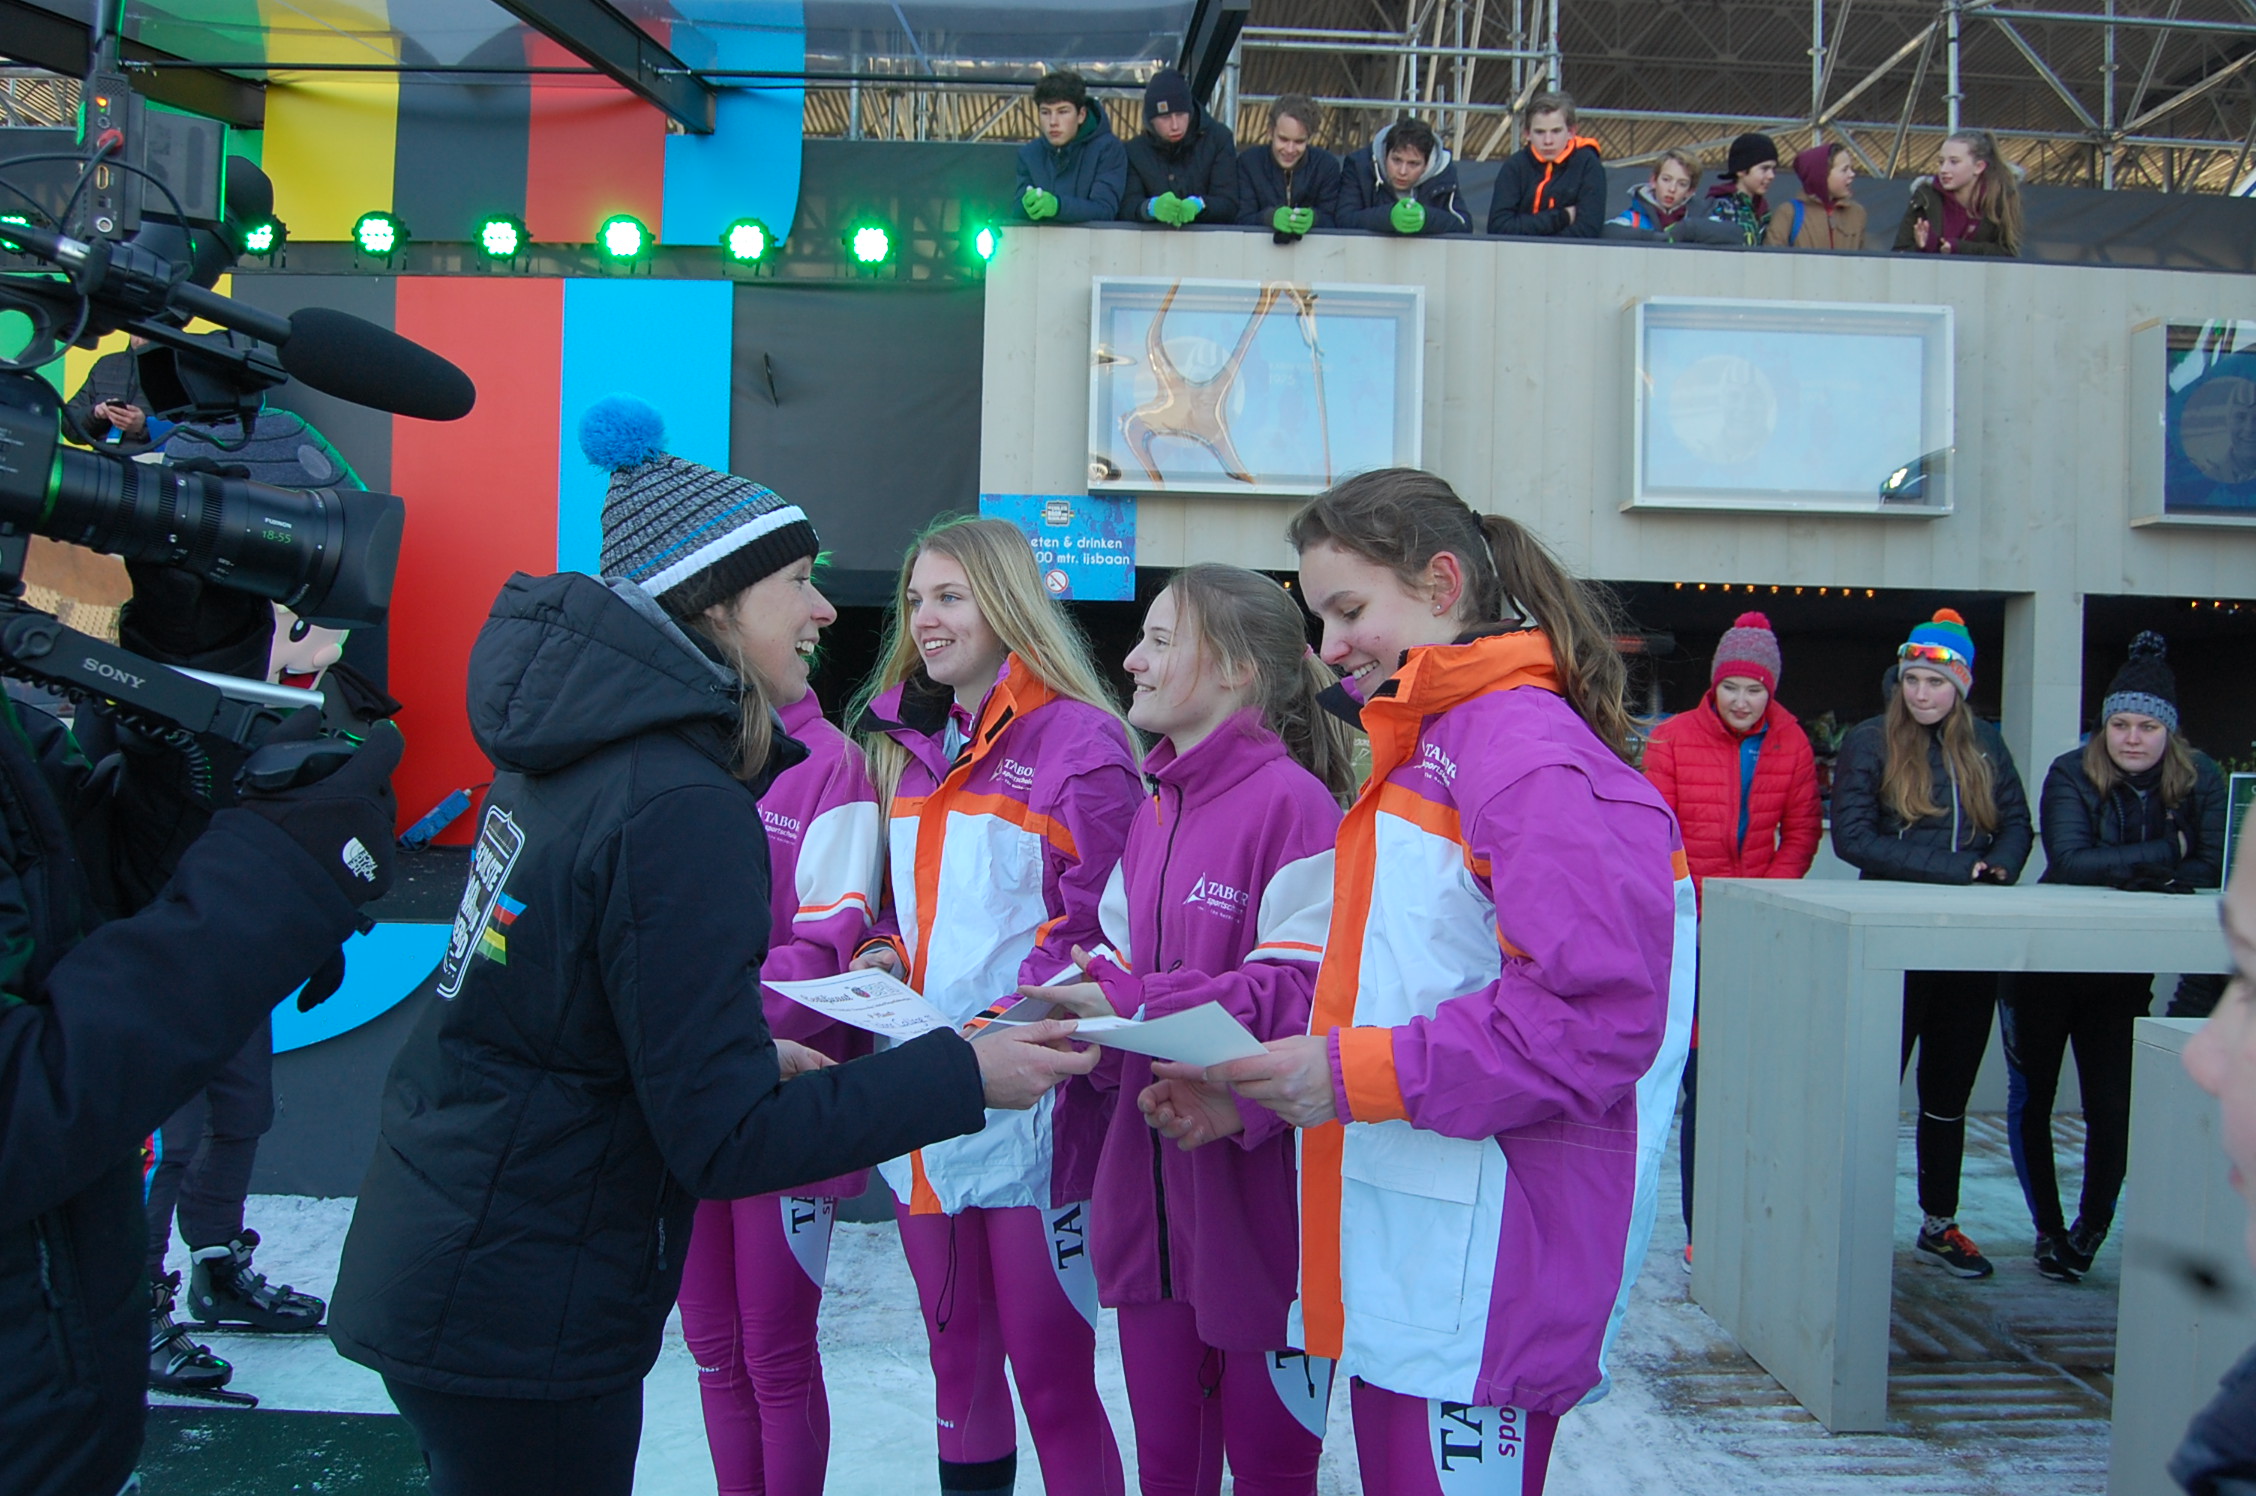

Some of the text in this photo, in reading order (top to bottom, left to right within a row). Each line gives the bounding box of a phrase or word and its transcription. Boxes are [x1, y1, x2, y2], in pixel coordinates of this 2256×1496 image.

[262, 530, 293, 544] 18-55
[1031, 536, 1123, 549] eten & drinken
[1057, 554, 1079, 564] mtr.
[1083, 553, 1130, 565] ijsbaan
[83, 657, 146, 689] SONY
[1053, 1203, 1085, 1270] TA
[1441, 1402, 1483, 1472] TA
[1498, 1406, 1522, 1458] spo
